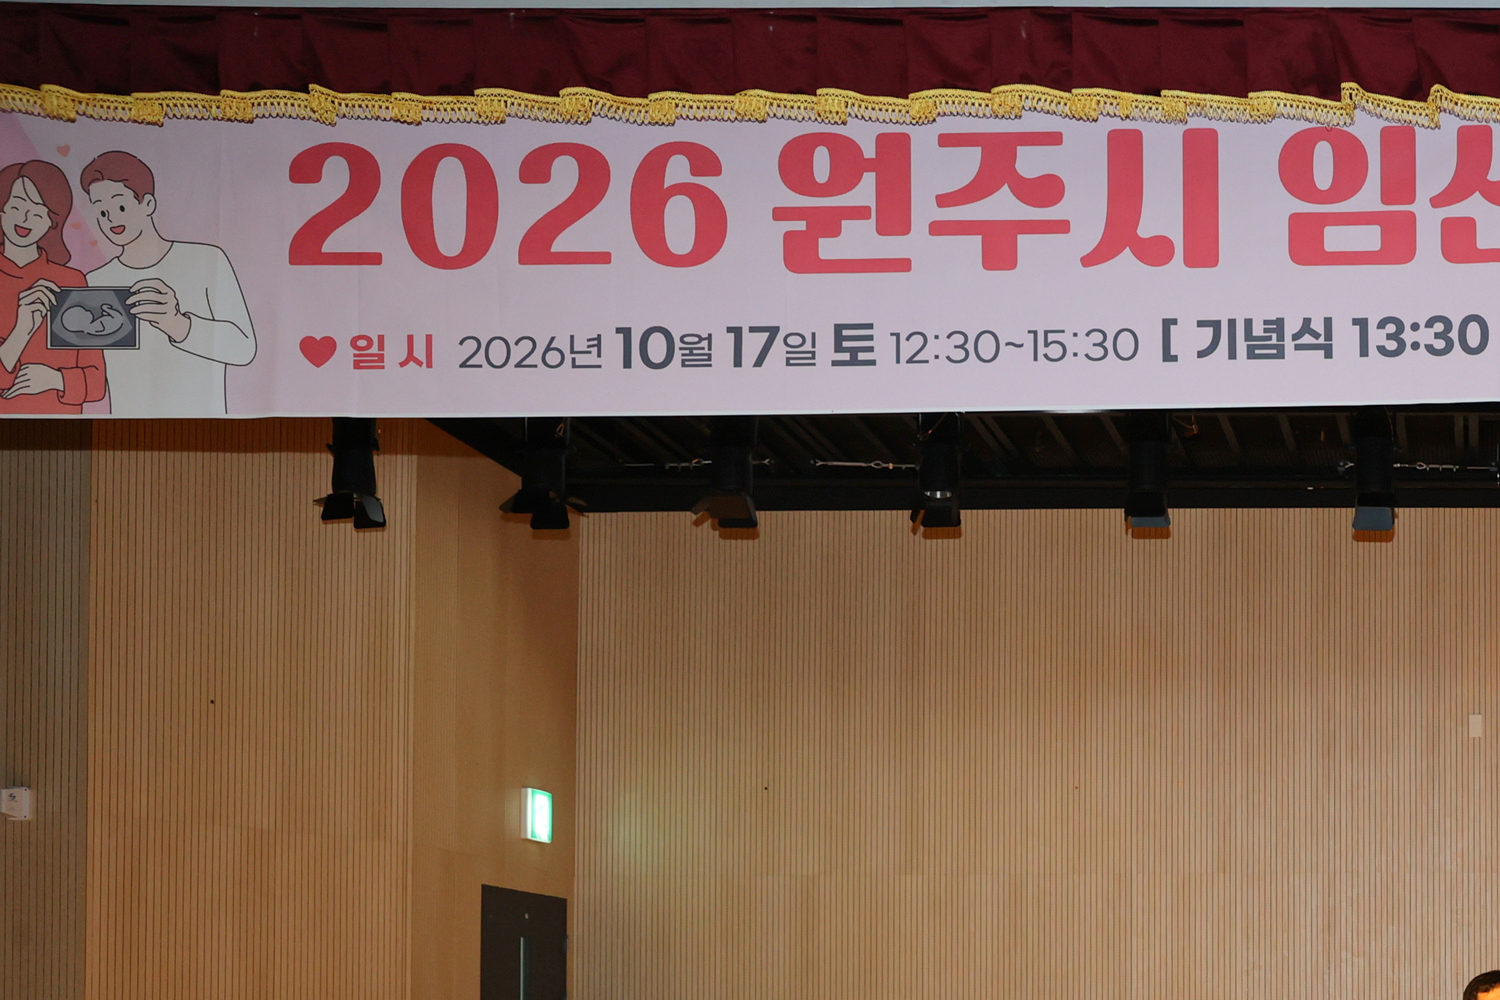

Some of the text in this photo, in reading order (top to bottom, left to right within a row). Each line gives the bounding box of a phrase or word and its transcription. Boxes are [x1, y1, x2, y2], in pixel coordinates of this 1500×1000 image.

[289, 142, 728, 271] 2026
[772, 130, 1220, 275] 원주시
[459, 334, 602, 369] 2026년
[615, 326, 712, 369] 10월
[727, 326, 817, 368] 17일
[831, 323, 876, 367] 토
[890, 328, 1139, 364] 12:30~15:30
[1195, 316, 1334, 360] 기념식
[1352, 314, 1490, 358] 13:30
